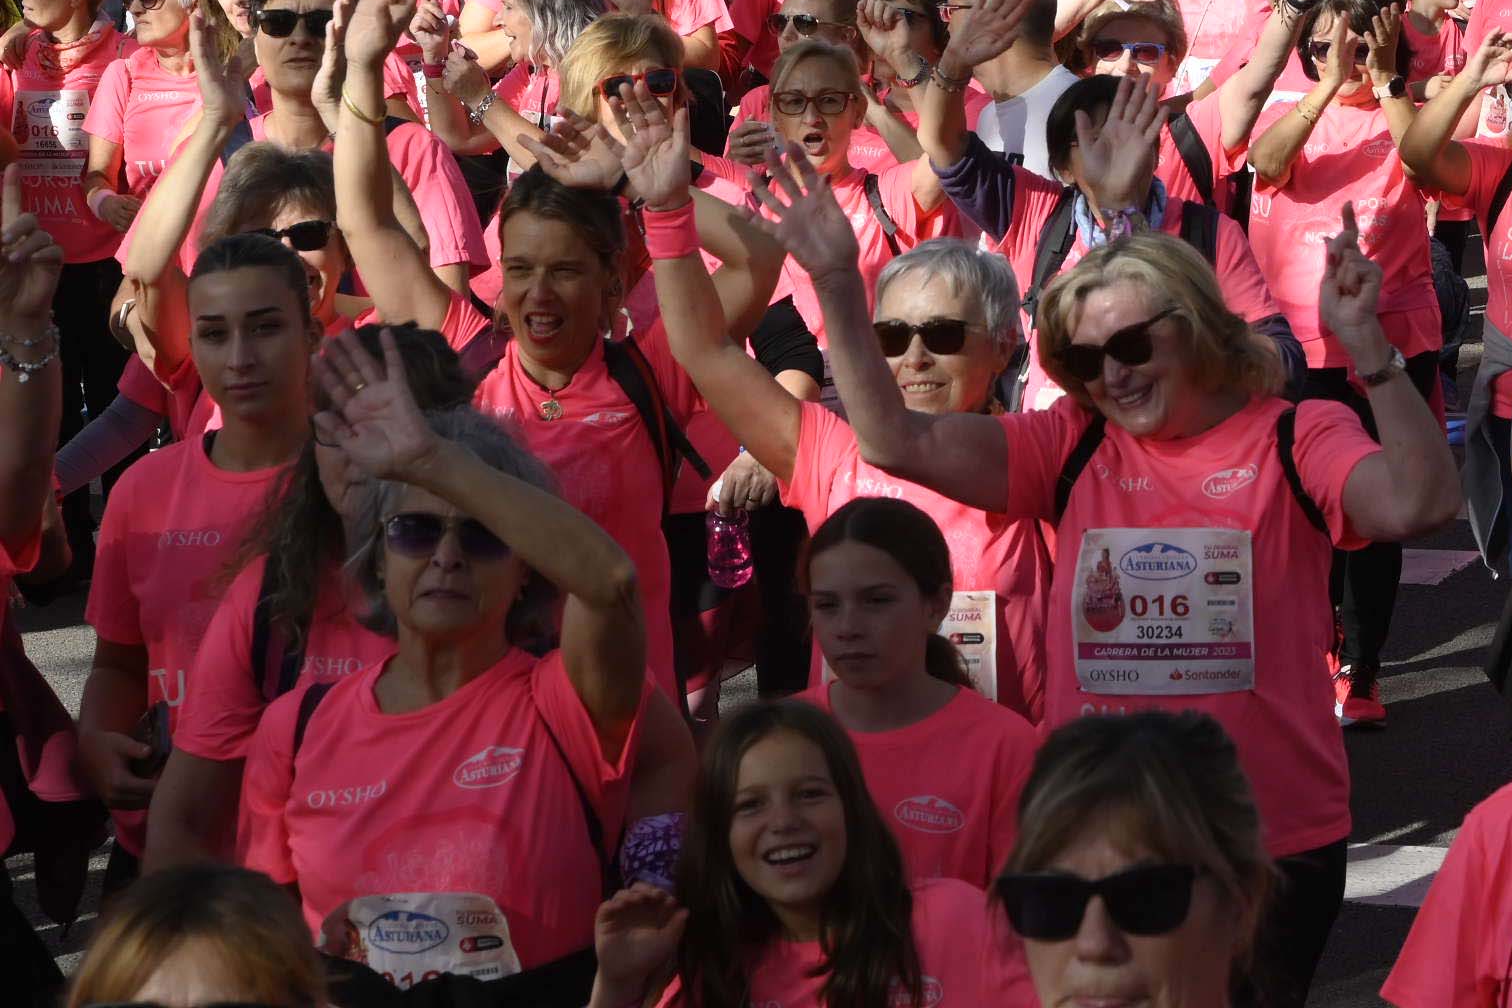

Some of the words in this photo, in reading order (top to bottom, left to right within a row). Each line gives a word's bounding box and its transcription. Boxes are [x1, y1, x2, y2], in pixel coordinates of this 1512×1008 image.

[1203, 550, 1240, 560] SUMA
[1125, 556, 1191, 572] ASTURIANA
[1129, 594, 1190, 618] 016
[949, 612, 983, 624] SUMA
[1136, 625, 1183, 640] 30234
[1094, 647, 1138, 657] CARRERA
[1141, 647, 1155, 657] DE
[1157, 647, 1170, 657] LA
[1172, 647, 1209, 657] MUJER
[1089, 668, 1139, 682] OYSHO
[1183, 669, 1241, 681] Santander
[307, 780, 388, 809] OYSHO
[372, 924, 443, 944] ASTURIANA
